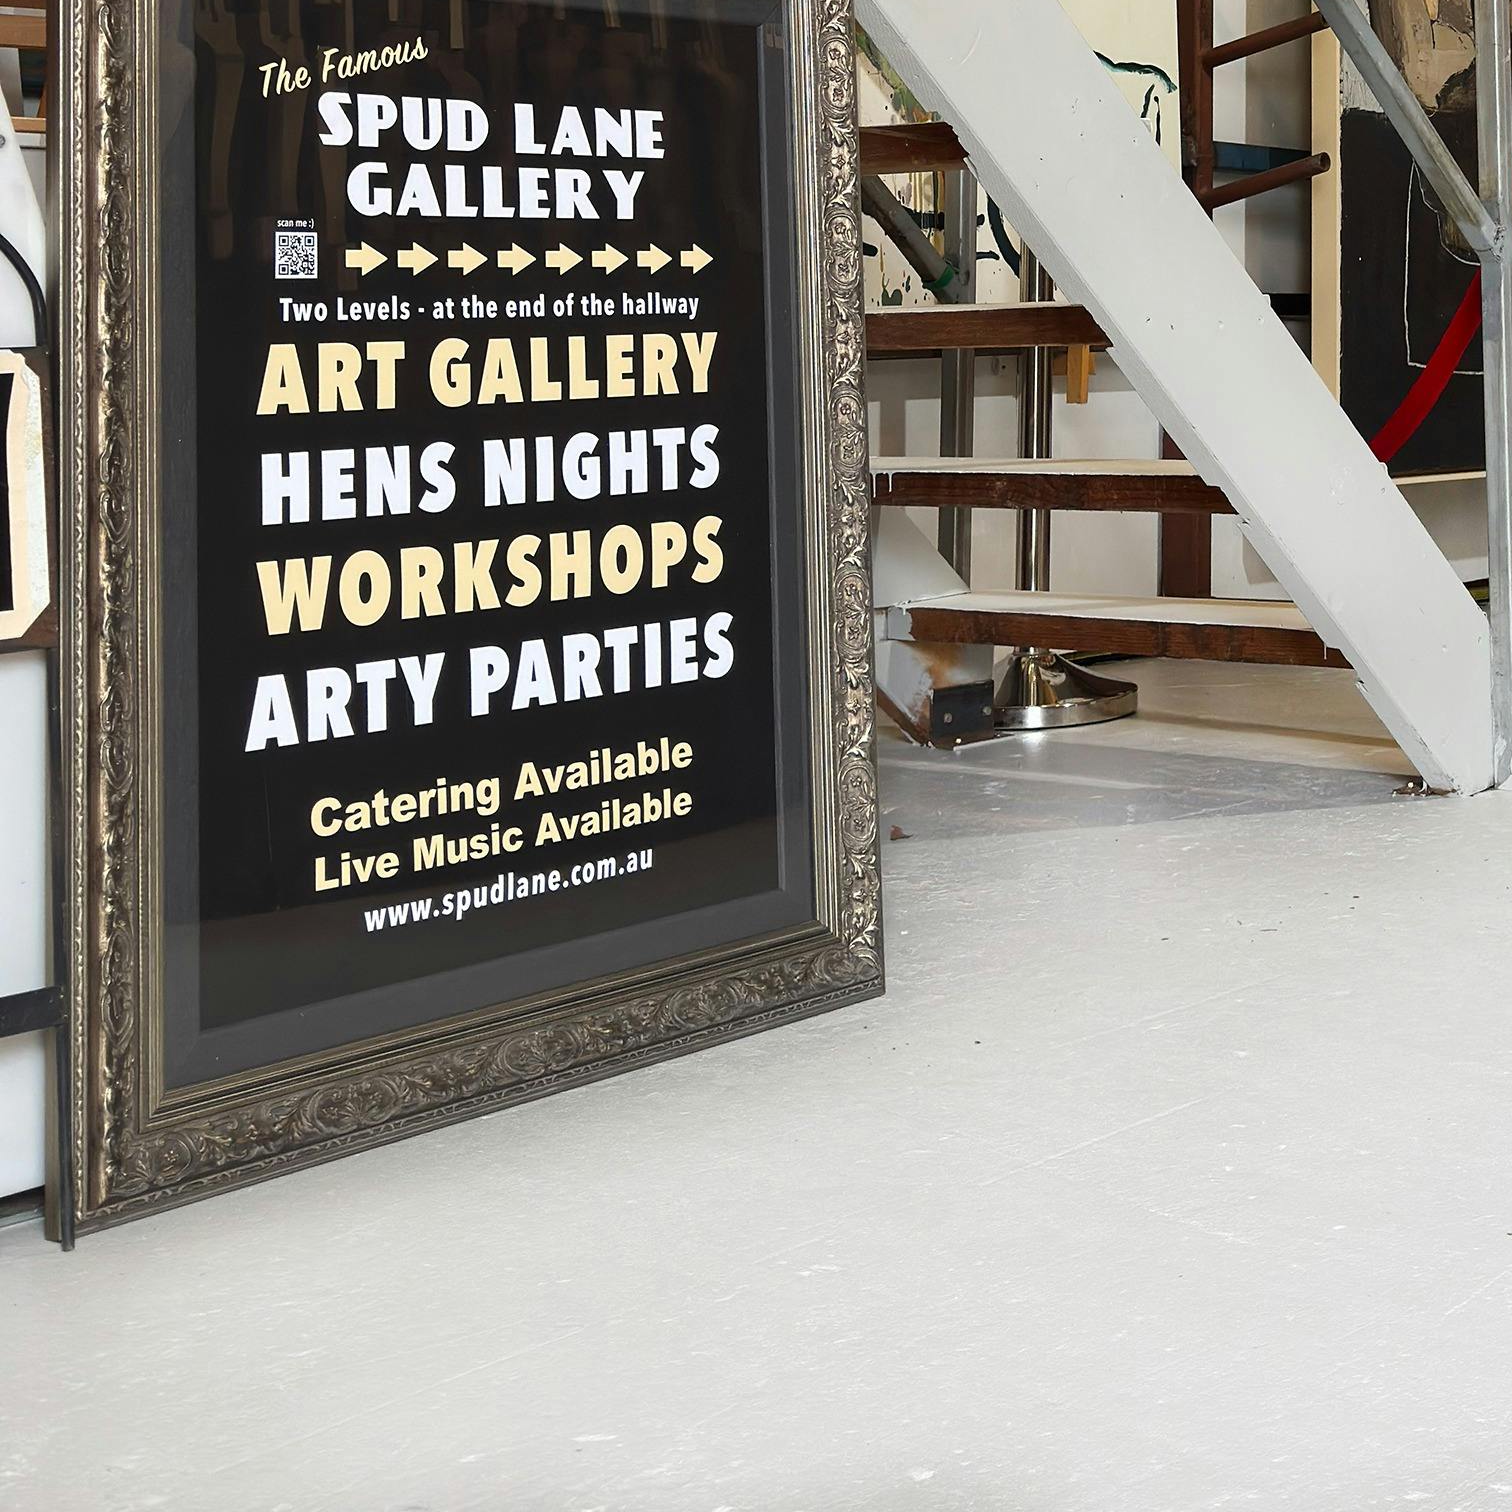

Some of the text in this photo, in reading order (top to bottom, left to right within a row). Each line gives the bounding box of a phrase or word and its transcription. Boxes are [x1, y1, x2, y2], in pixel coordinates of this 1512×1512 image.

[258, 36, 429, 98] The Famous
[317, 91, 666, 159] SPUD LANE
[276, 219, 295, 228] scan
[295, 219, 308, 228] me
[346, 161, 645, 220] GALLERY
[279, 297, 328, 322] Two
[336, 294, 411, 321] Levels
[432, 297, 455, 320] at
[460, 294, 498, 319] the
[505, 293, 546, 319] end
[552, 292, 575, 318] of
[580, 292, 615, 317] the
[622, 291, 700, 321] hallway
[255, 331, 718, 416] ART GALLERY
[260, 423, 720, 526] HENS NIGHTS
[255, 515, 724, 636] WORKSHOPS
[244, 611, 735, 753] ARTY PARTIES
[310, 736, 694, 838] Catering Available
[315, 787, 693, 892] Live Music Available
[363, 848, 653, 934] www.spudlane.com.au
